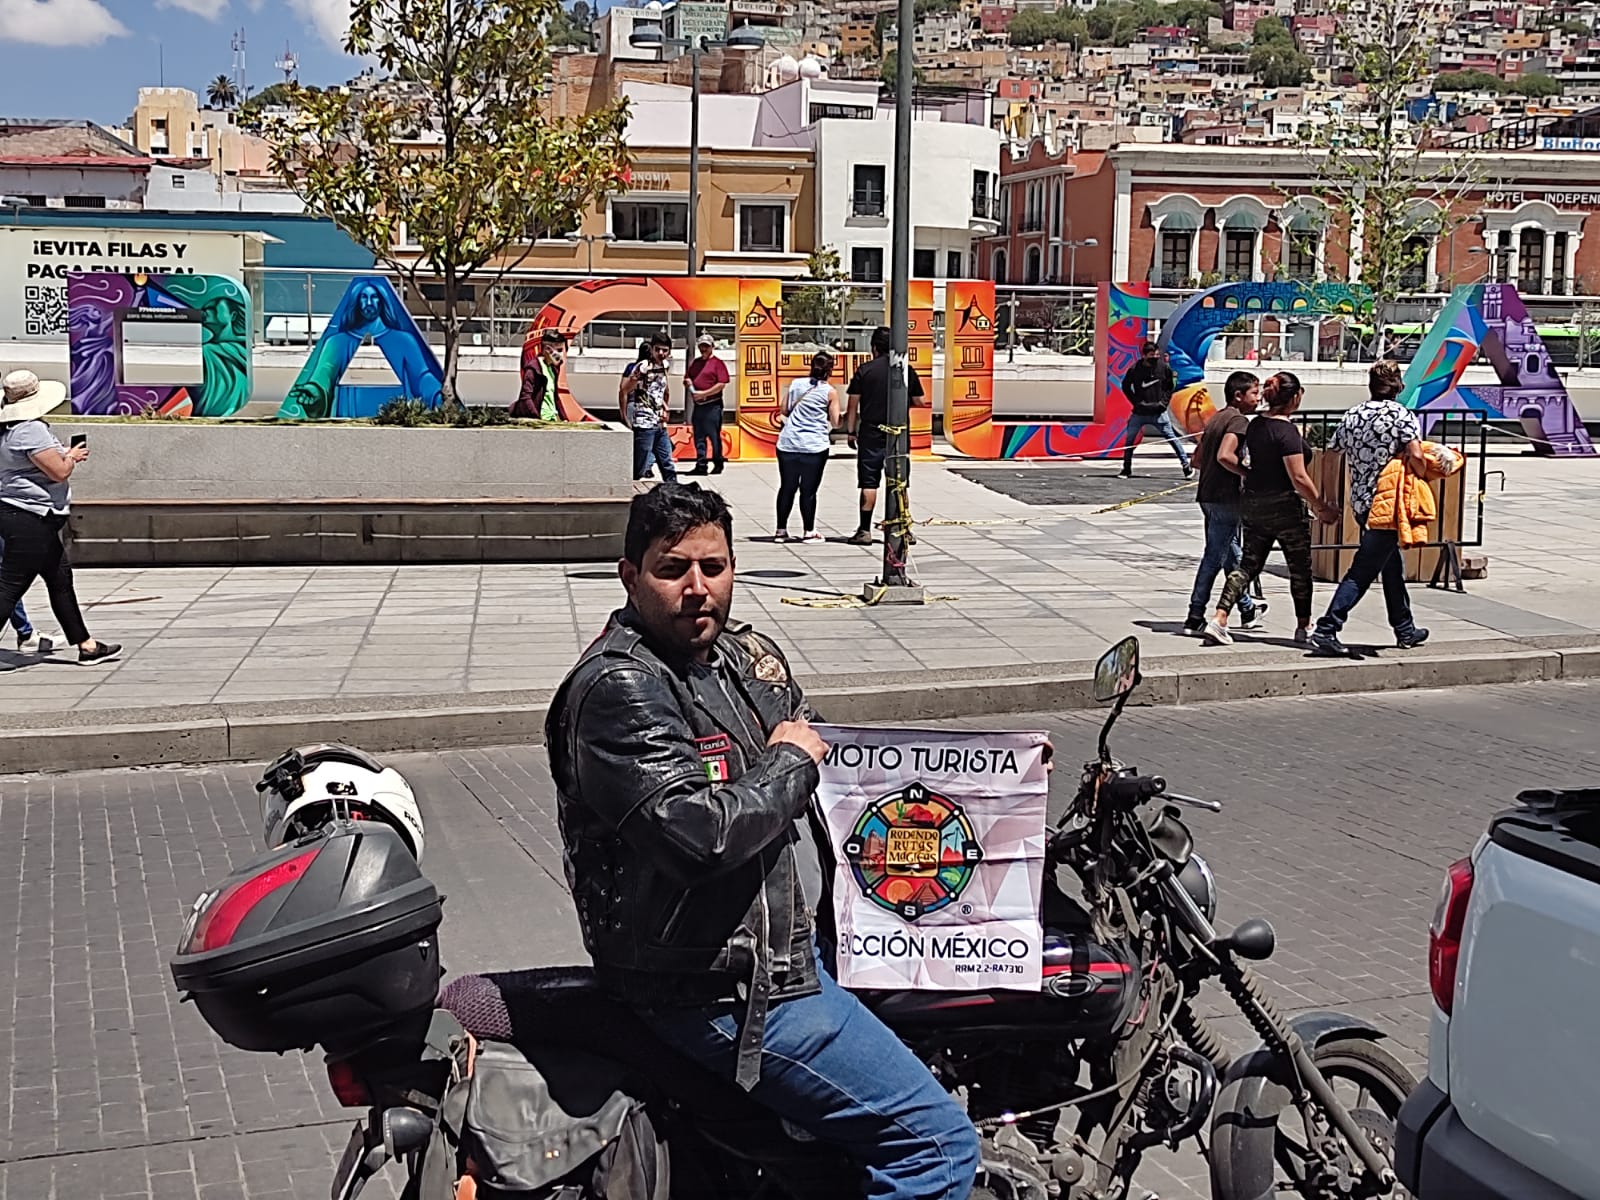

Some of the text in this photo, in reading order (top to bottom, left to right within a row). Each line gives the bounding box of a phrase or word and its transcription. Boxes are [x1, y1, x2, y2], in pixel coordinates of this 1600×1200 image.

[1486, 191, 1526, 203] HOTEL
[33, 240, 187, 258] ¡EVITA FILAS Y
[27, 263, 82, 279] PAGA
[823, 743, 1018, 774] MOTO TURISTA
[910, 789, 923, 799] N
[966, 849, 978, 859] E
[904, 905, 916, 916] S
[932, 932, 1029, 958] MÉXICO
[955, 964, 975, 973] RRM
